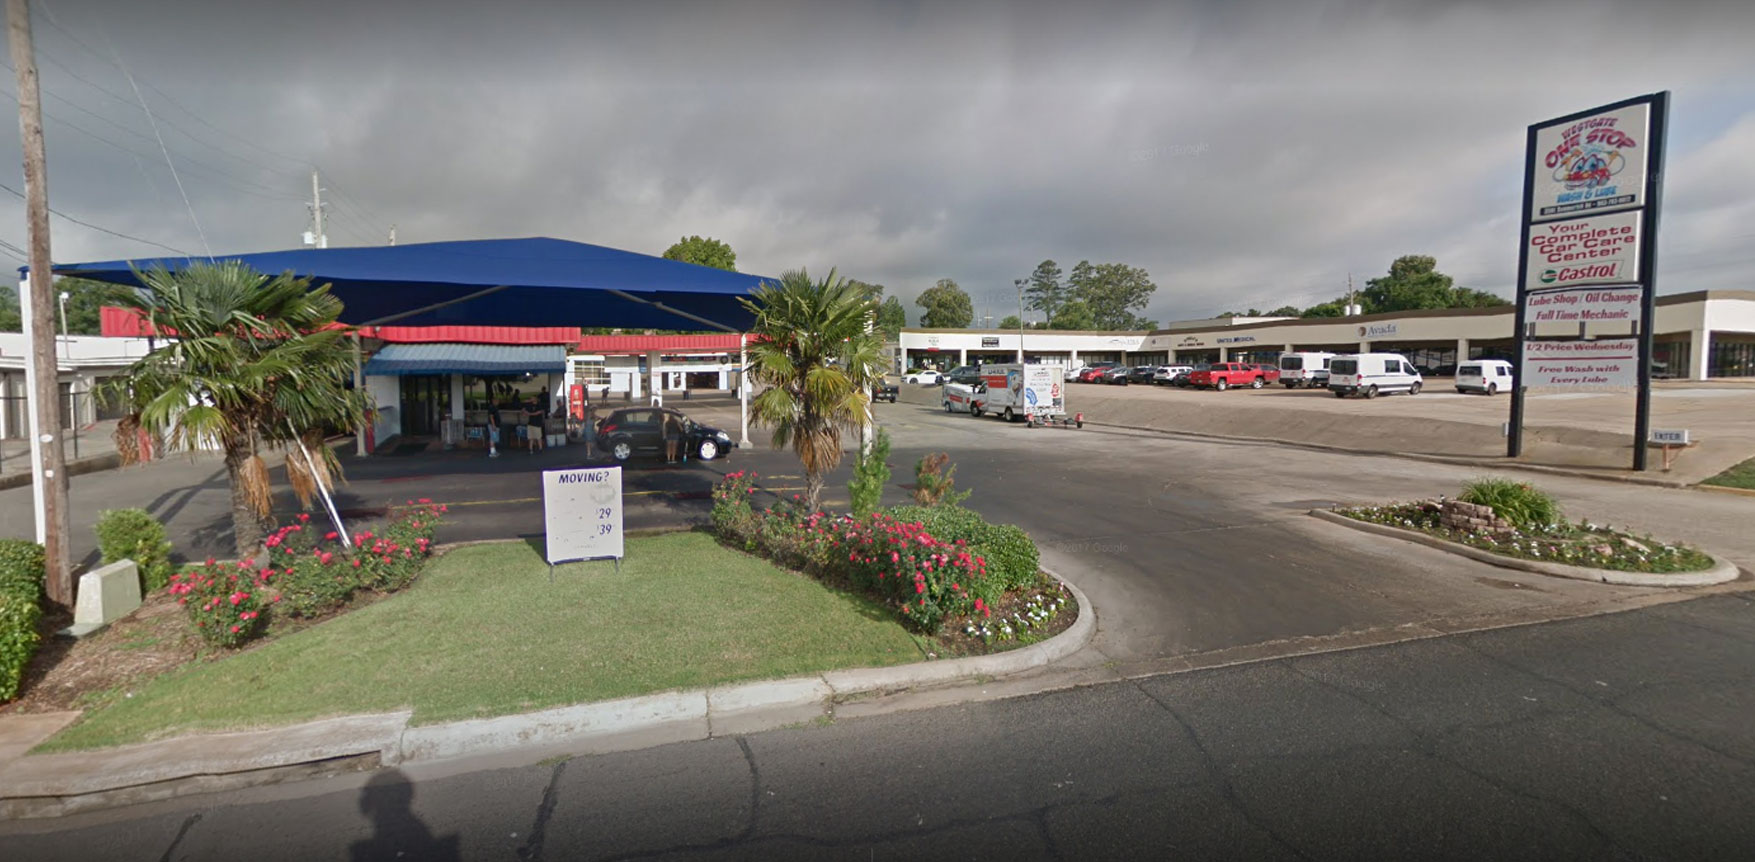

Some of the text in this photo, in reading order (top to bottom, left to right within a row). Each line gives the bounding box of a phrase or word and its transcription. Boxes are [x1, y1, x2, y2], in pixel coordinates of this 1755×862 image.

[1561, 117, 1619, 140] WESTGATE
[1545, 127, 1636, 169] ONE STOP
[1549, 223, 1589, 234] Your
[1531, 226, 1632, 246] Complete
[1540, 235, 1635, 254] Car Care
[1547, 247, 1622, 263] Center
[1558, 263, 1617, 281] Castrol
[1528, 297, 1552, 306] Lube
[1553, 294, 1578, 304] Shop
[1585, 292, 1600, 303] Oil
[1601, 292, 1639, 303] Change
[1536, 309, 1629, 320] Full Time Mechanic
[1543, 343, 1572, 351] Price
[1574, 342, 1635, 351] Wednesday
[1564, 365, 1594, 373] Wash
[1550, 376, 1579, 384] Every
[558, 471, 610, 484] MOVING?
[596, 508, 612, 519] 29
[596, 523, 612, 535] 39
